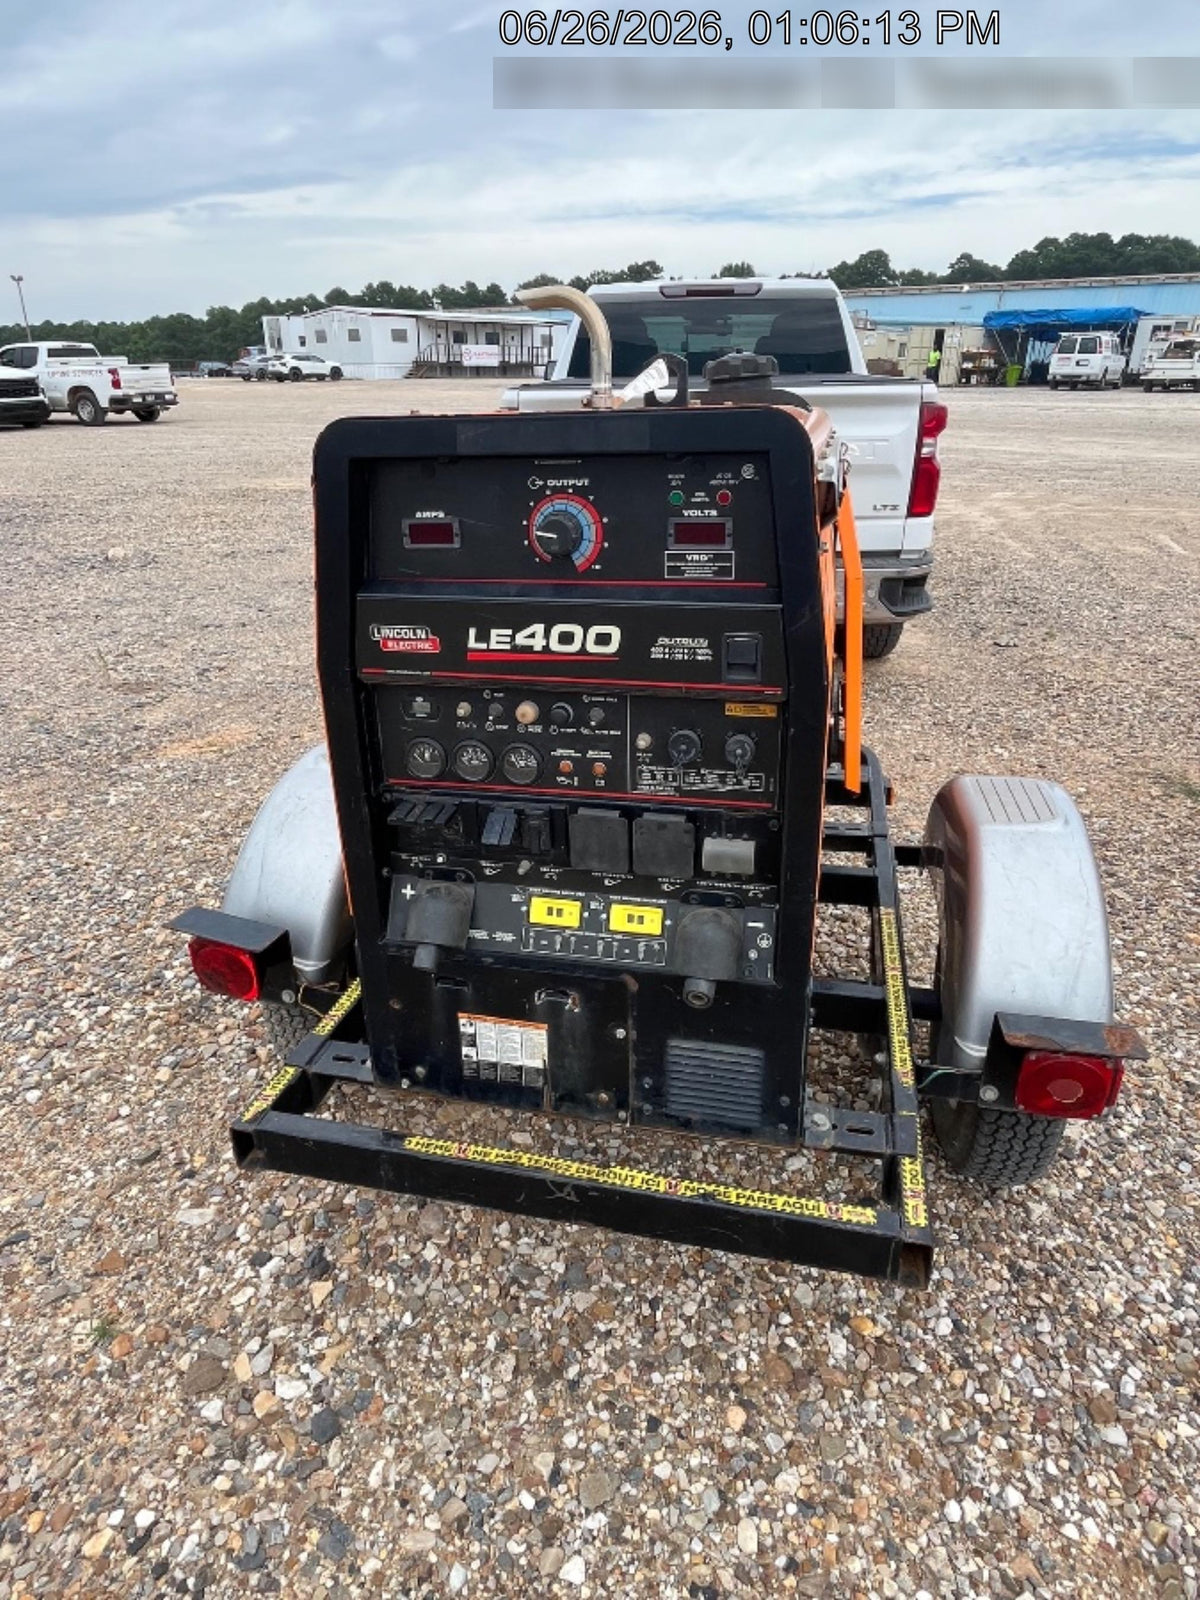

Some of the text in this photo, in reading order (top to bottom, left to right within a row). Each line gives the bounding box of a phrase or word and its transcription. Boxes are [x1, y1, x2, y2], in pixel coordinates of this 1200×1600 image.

[547, 478, 589, 486] OUTPUT
[872, 503, 901, 511] LTZ
[415, 510, 445, 518] AMPS
[682, 509, 718, 517] VOLTS
[373, 627, 428, 640] LINCOLN
[467, 623, 622, 654] LE400
[387, 641, 434, 651] ELECTRIC
[640, 1178, 661, 1189] ICI
[736, 1193, 778, 1206] PARE
